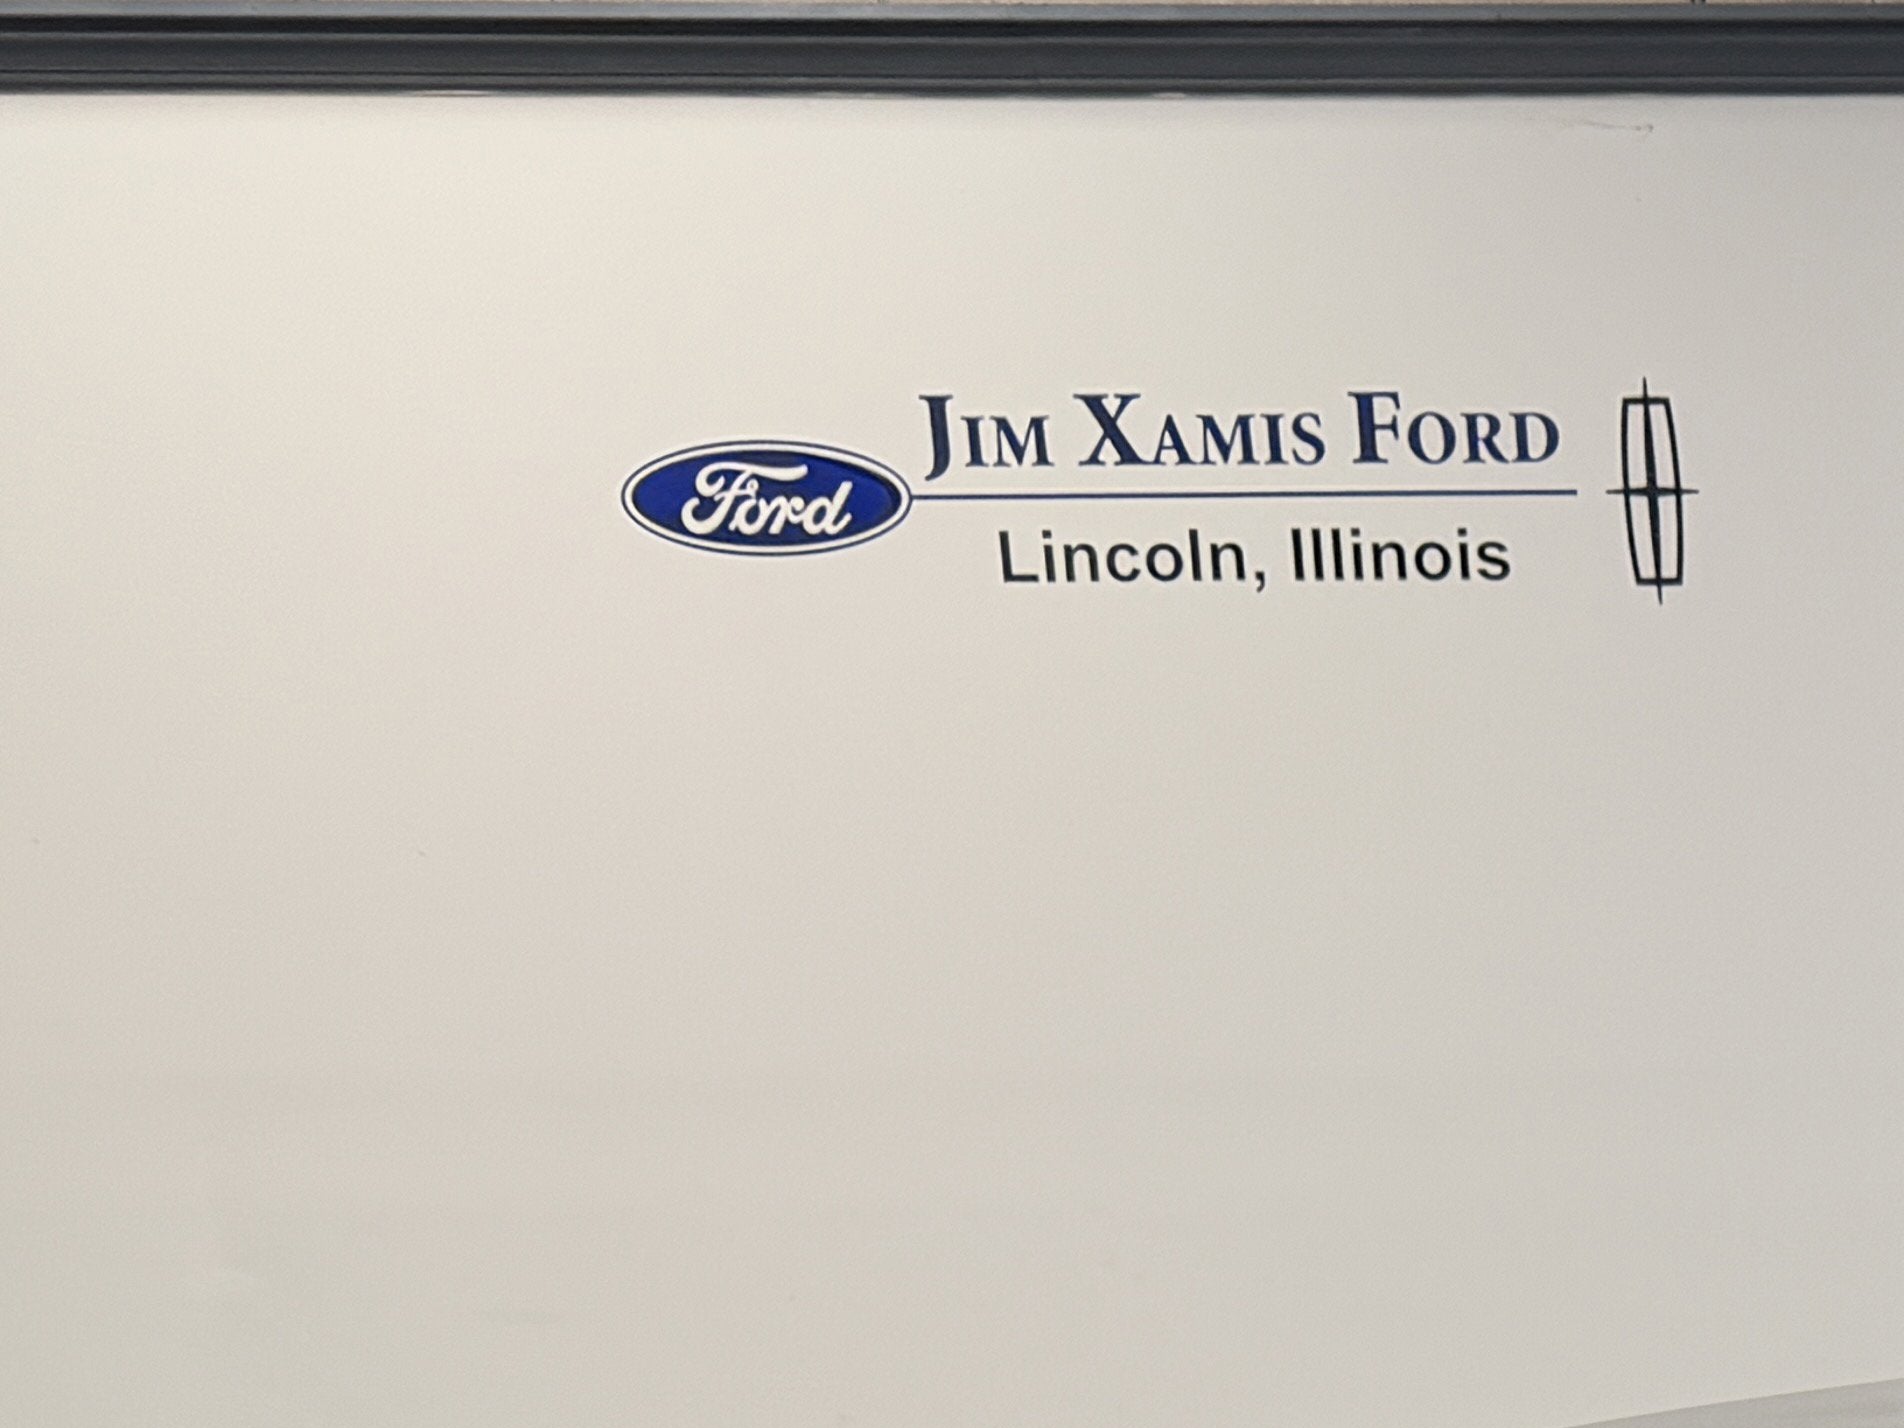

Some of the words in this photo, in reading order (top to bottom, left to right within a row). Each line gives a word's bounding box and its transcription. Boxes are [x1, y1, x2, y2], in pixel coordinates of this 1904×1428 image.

[919, 394, 1054, 481] JIM
[1072, 393, 1326, 467] XAMIS
[1347, 391, 1560, 465] FORD
[681, 462, 853, 538] Ford
[999, 528, 1267, 592] Lincoln,
[1292, 527, 1511, 583] Illinois
